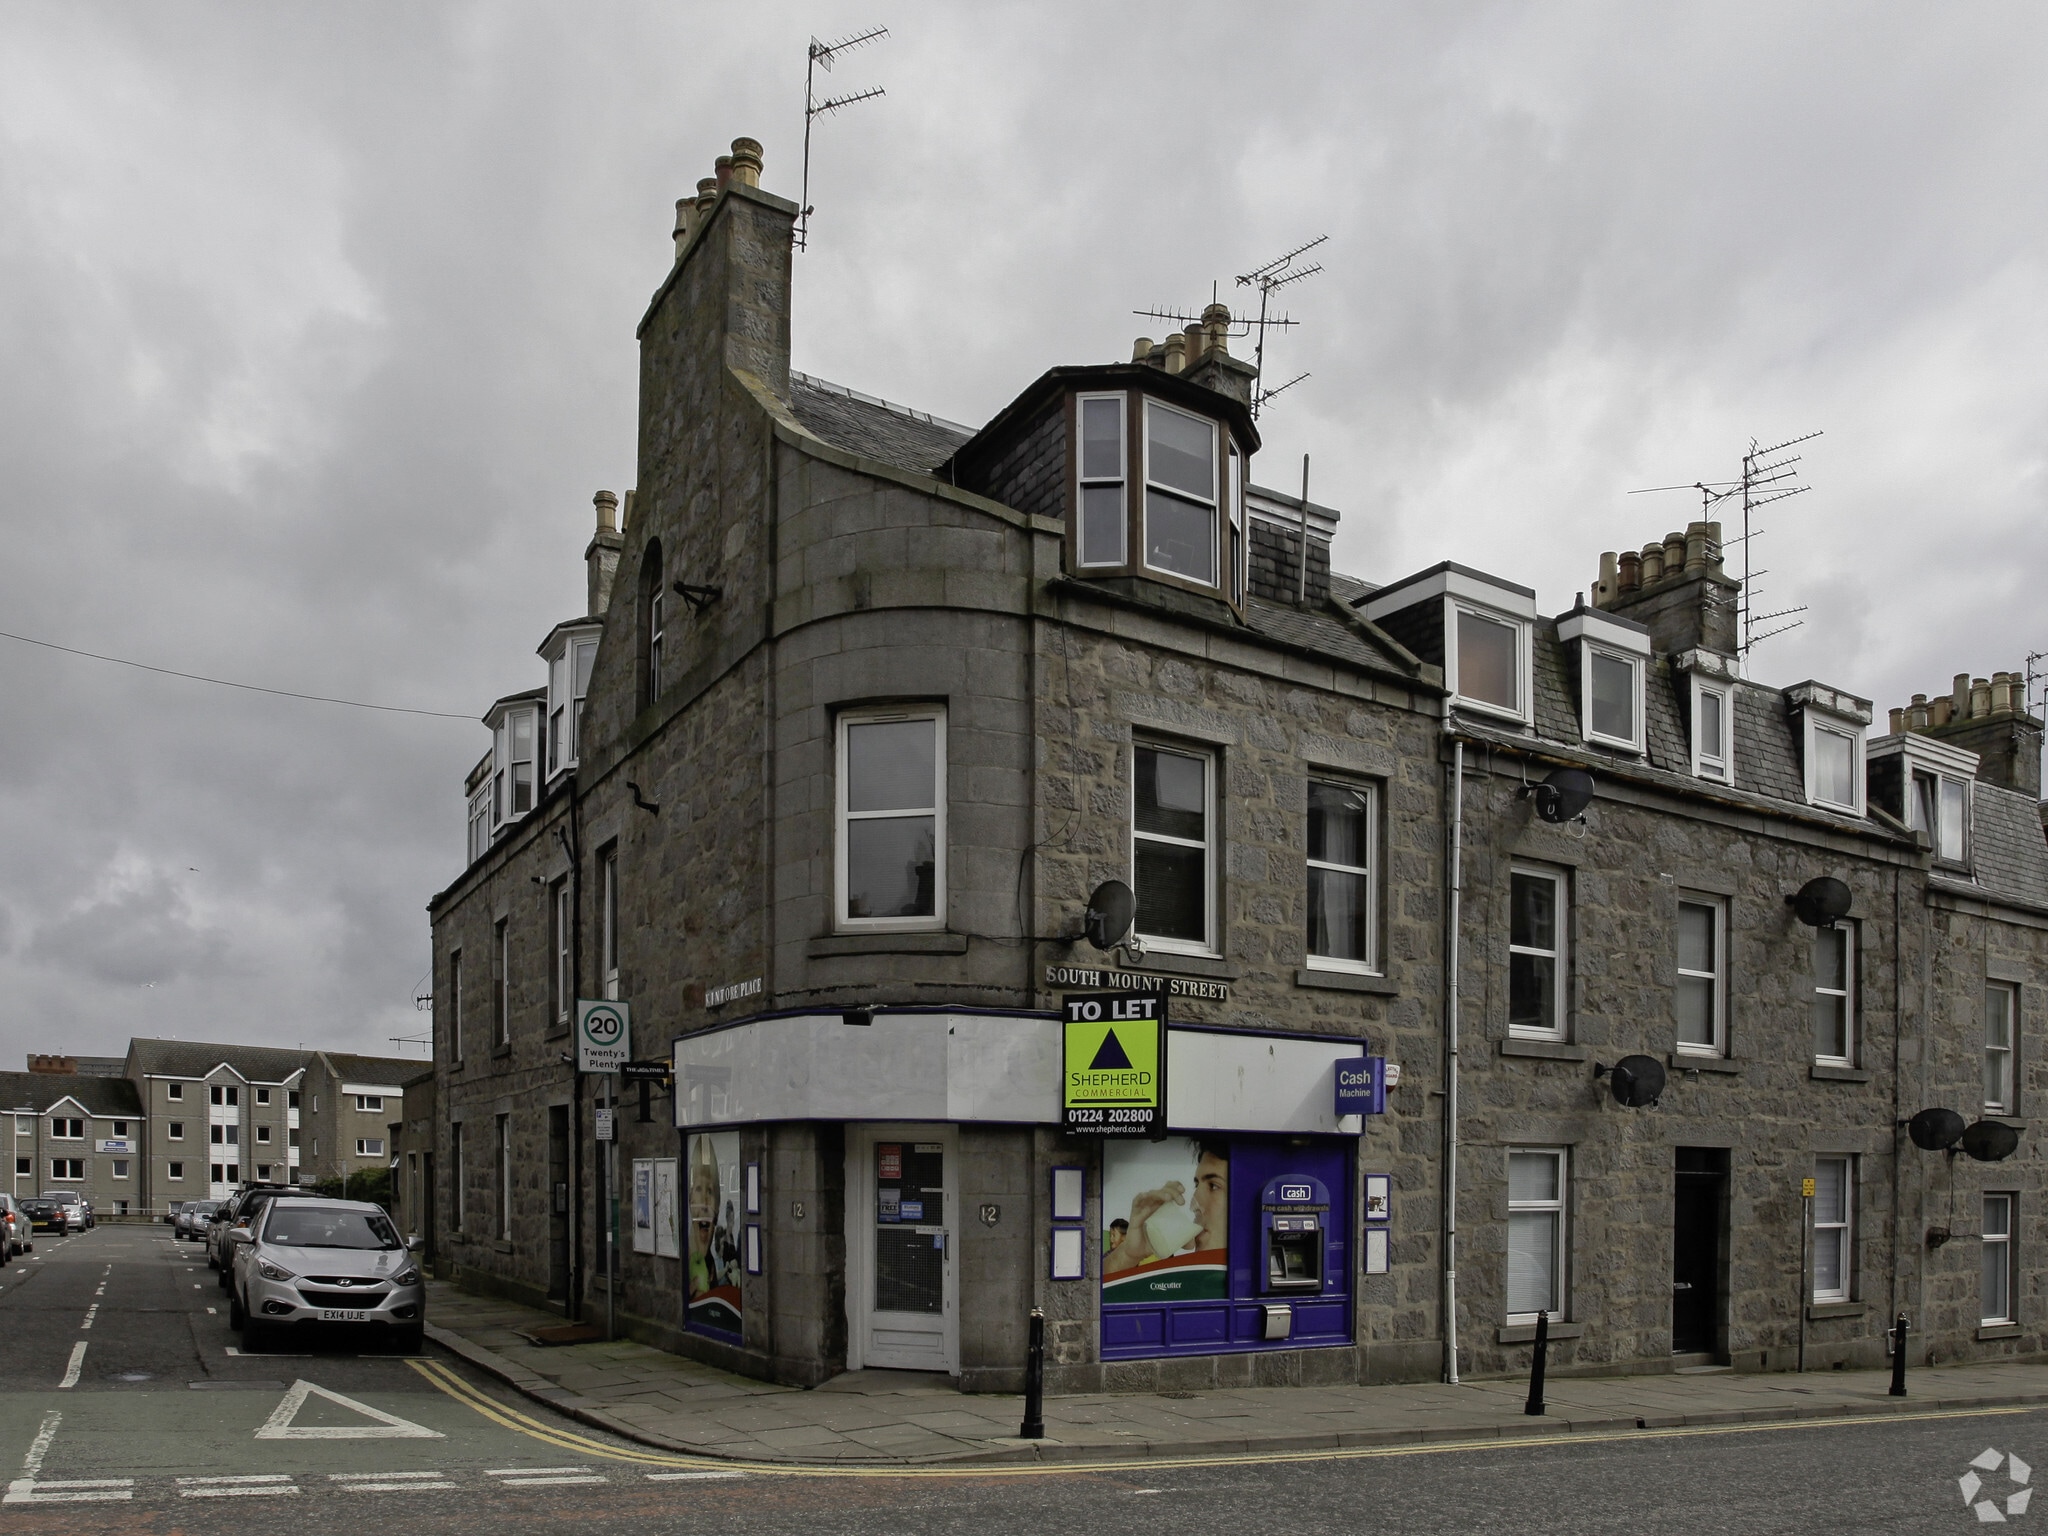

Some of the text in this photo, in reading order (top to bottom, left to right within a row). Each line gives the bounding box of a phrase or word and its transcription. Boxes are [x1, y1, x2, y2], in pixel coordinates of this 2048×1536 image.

[740, 978, 762, 997] PLACE
[1046, 967, 1227, 999] SOUTH MOUNT STREET
[1068, 999, 1156, 1021] TO LET
[590, 1016, 618, 1035] 20
[584, 1048, 625, 1058] Twenty's
[589, 1060, 619, 1069] Plenty
[1071, 1071, 1152, 1087] SHEPHERD
[1340, 1070, 1371, 1085] Cash
[1075, 1088, 1146, 1097] COMMERCIAL
[1340, 1088, 1371, 1097] Machine
[1068, 1109, 1153, 1122] 01224 202800
[1076, 1125, 1146, 1134] www.shepherd.co.uk
[1287, 1187, 1306, 1198] cash
[324, 1310, 365, 1320] EX14 UJE
